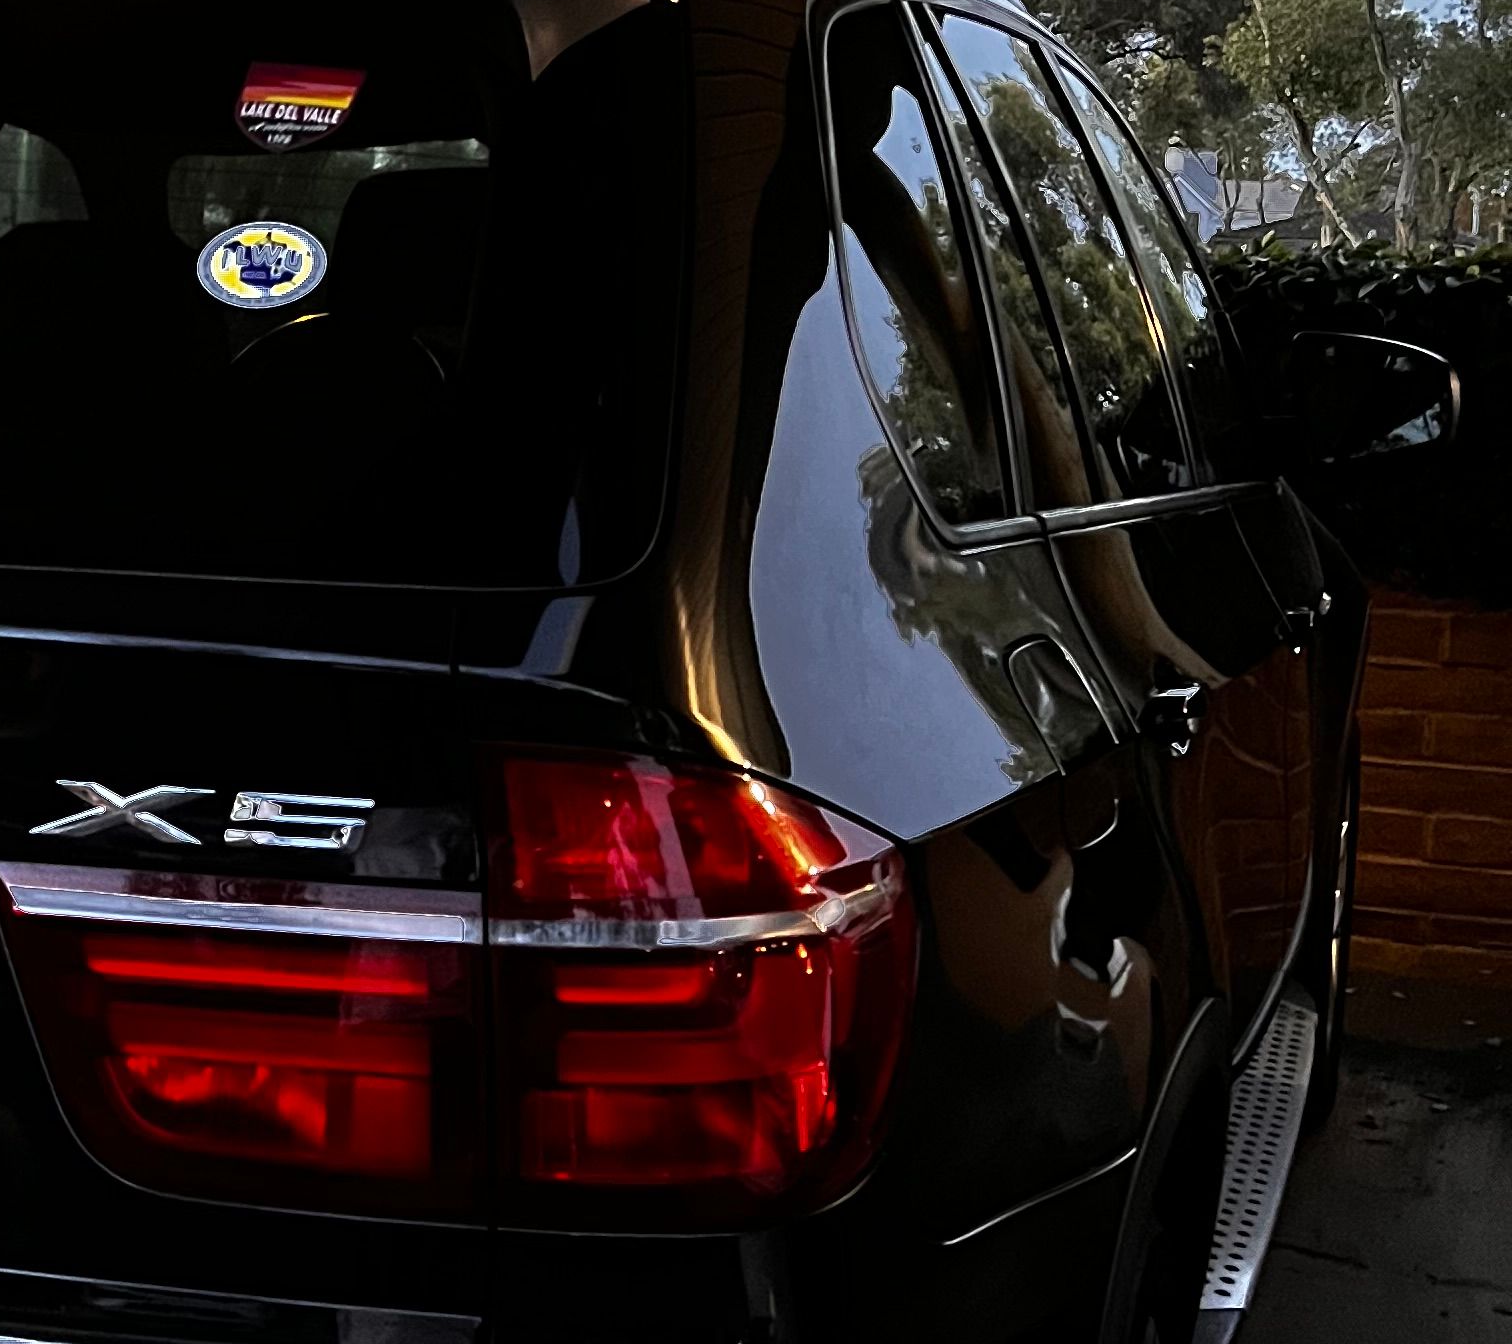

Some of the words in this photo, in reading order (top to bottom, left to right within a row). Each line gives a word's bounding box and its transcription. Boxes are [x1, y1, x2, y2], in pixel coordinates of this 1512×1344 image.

[240, 102, 275, 118] LAKE
[274, 104, 299, 121] DEL
[303, 106, 342, 124] VALLE
[29, 779, 376, 854] X5
